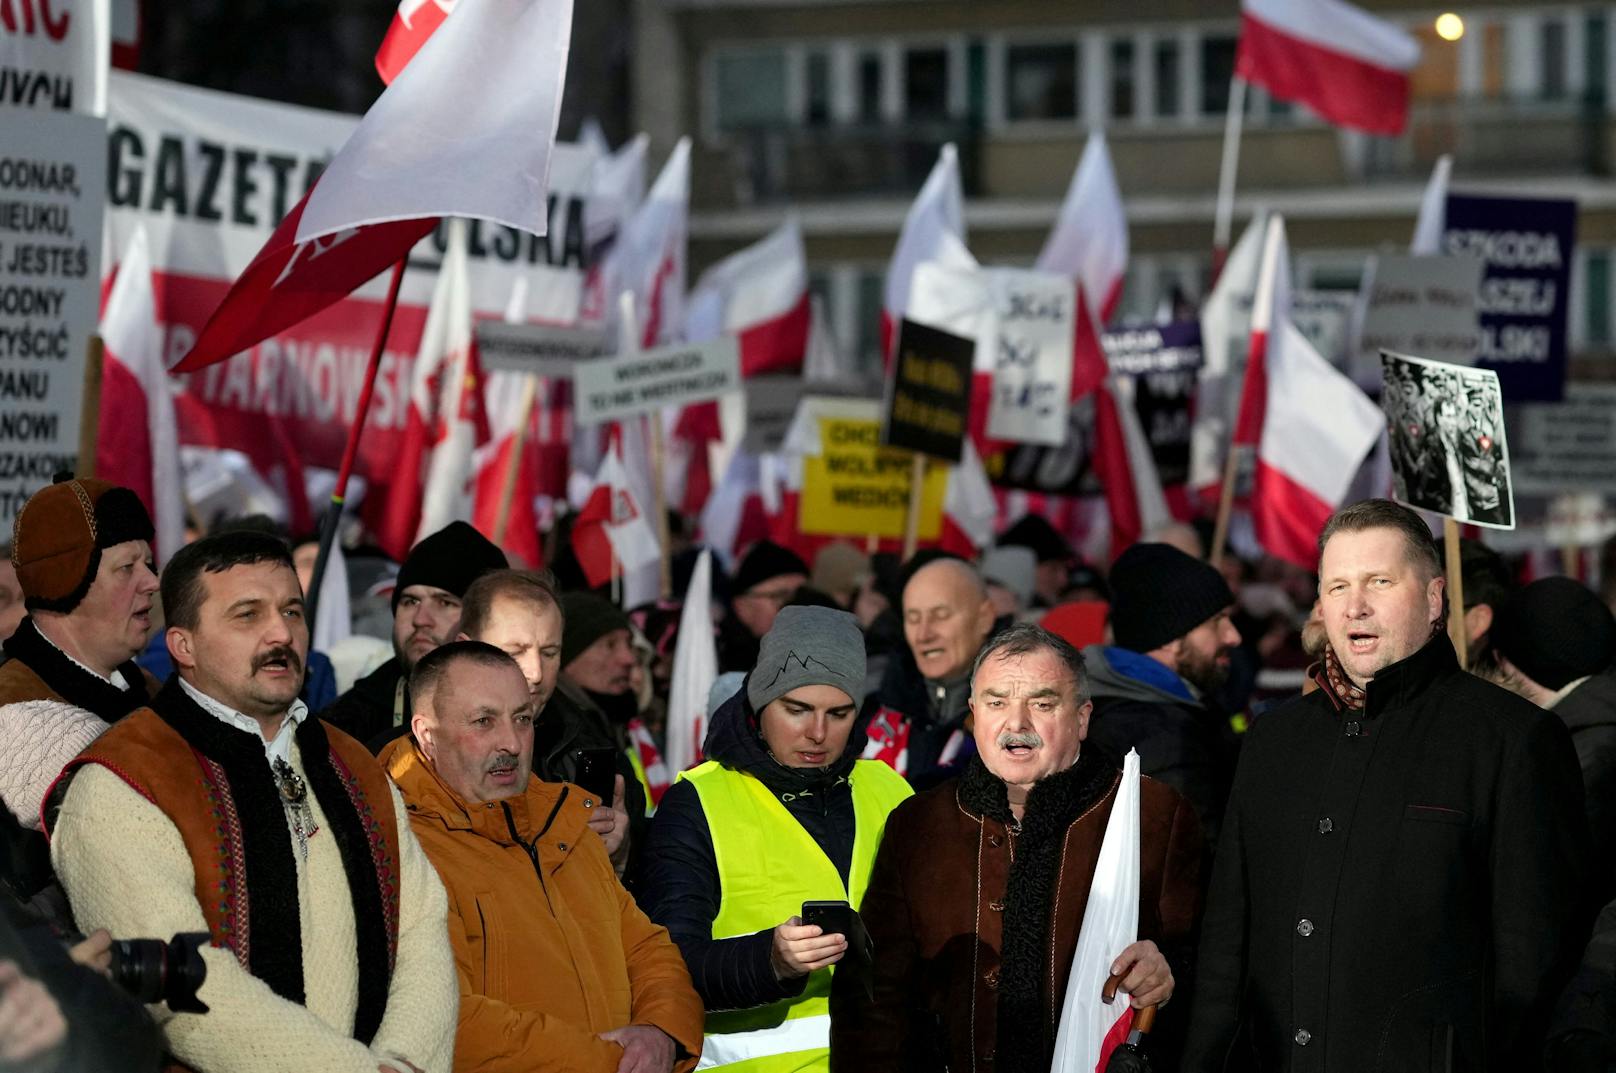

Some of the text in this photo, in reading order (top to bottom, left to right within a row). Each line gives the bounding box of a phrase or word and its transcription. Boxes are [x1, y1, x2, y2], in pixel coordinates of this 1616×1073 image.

[7, 241, 89, 278] JESTEŚ
[0, 285, 65, 320] ODNY
[0, 411, 59, 441] NOWI
